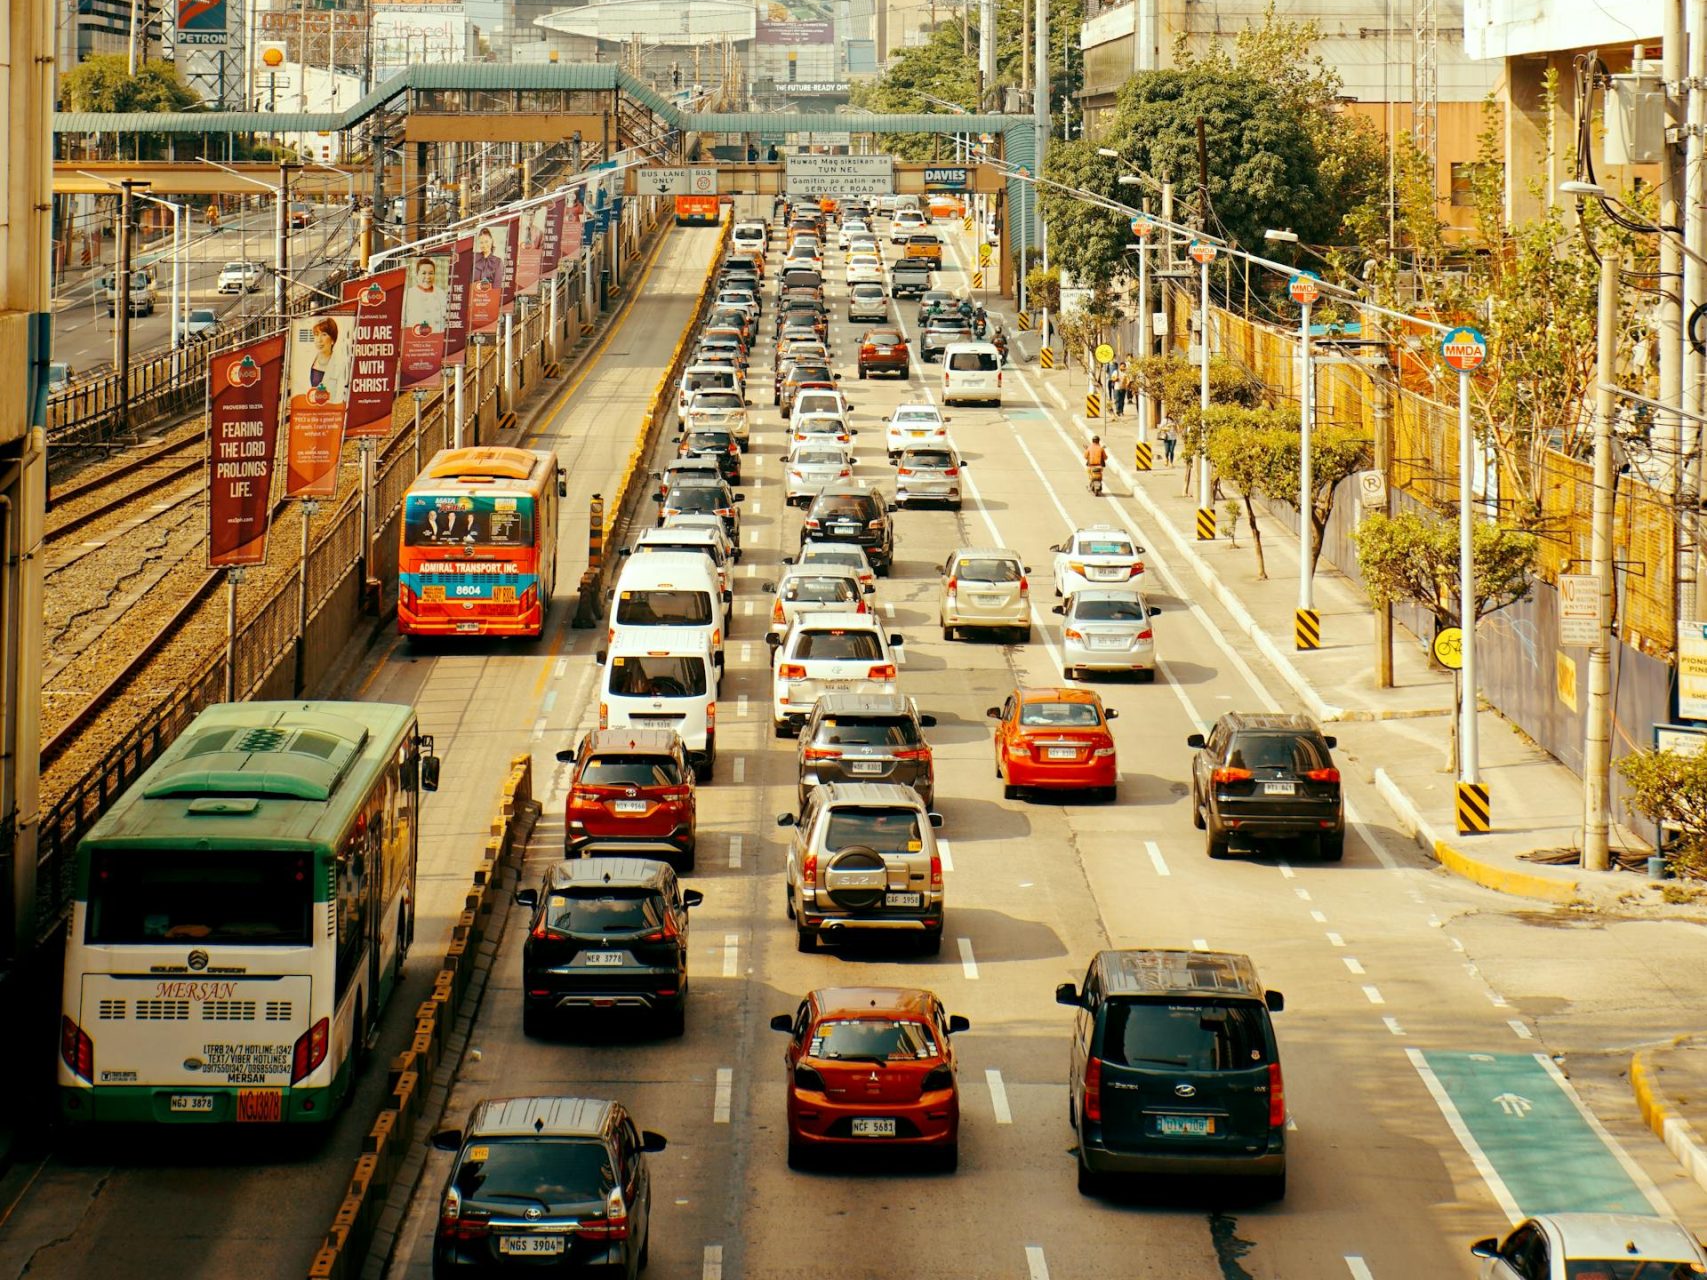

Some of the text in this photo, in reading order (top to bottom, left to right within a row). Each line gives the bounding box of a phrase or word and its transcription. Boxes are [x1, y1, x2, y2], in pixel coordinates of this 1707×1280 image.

[177, 32, 227, 44] PETRON
[925, 169, 966, 181] DAVIES
[805, 185, 846, 193] SERVICE
[373, 326, 393, 340] ARE
[1445, 345, 1483, 356] MMDA
[359, 360, 385, 375] WITH
[352, 377, 390, 392] CHRIST.
[222, 421, 264, 438] FEARING
[219, 441, 266, 458] THE LORD
[217, 461, 267, 478] PROLONGS
[230, 481, 253, 498] LIFE.
[420, 562, 454, 573] ADMIRAL
[503, 562, 519, 573] INC.
[1561, 579, 1574, 601] NO
[155, 982, 238, 1001] MERSAN
[203, 1044, 224, 1055] LTFRB
[226, 1044, 244, 1054] 24/7
[253, 1054, 287, 1064] HOTLINES
[228, 1073, 265, 1083] MERSAN
[172, 1098, 212, 1108] NGJ 3878
[238, 1090, 280, 1121] NGJ3878
[853, 1122, 894, 1132] NCF 5681
[509, 1240, 556, 1252] NGS 3904
